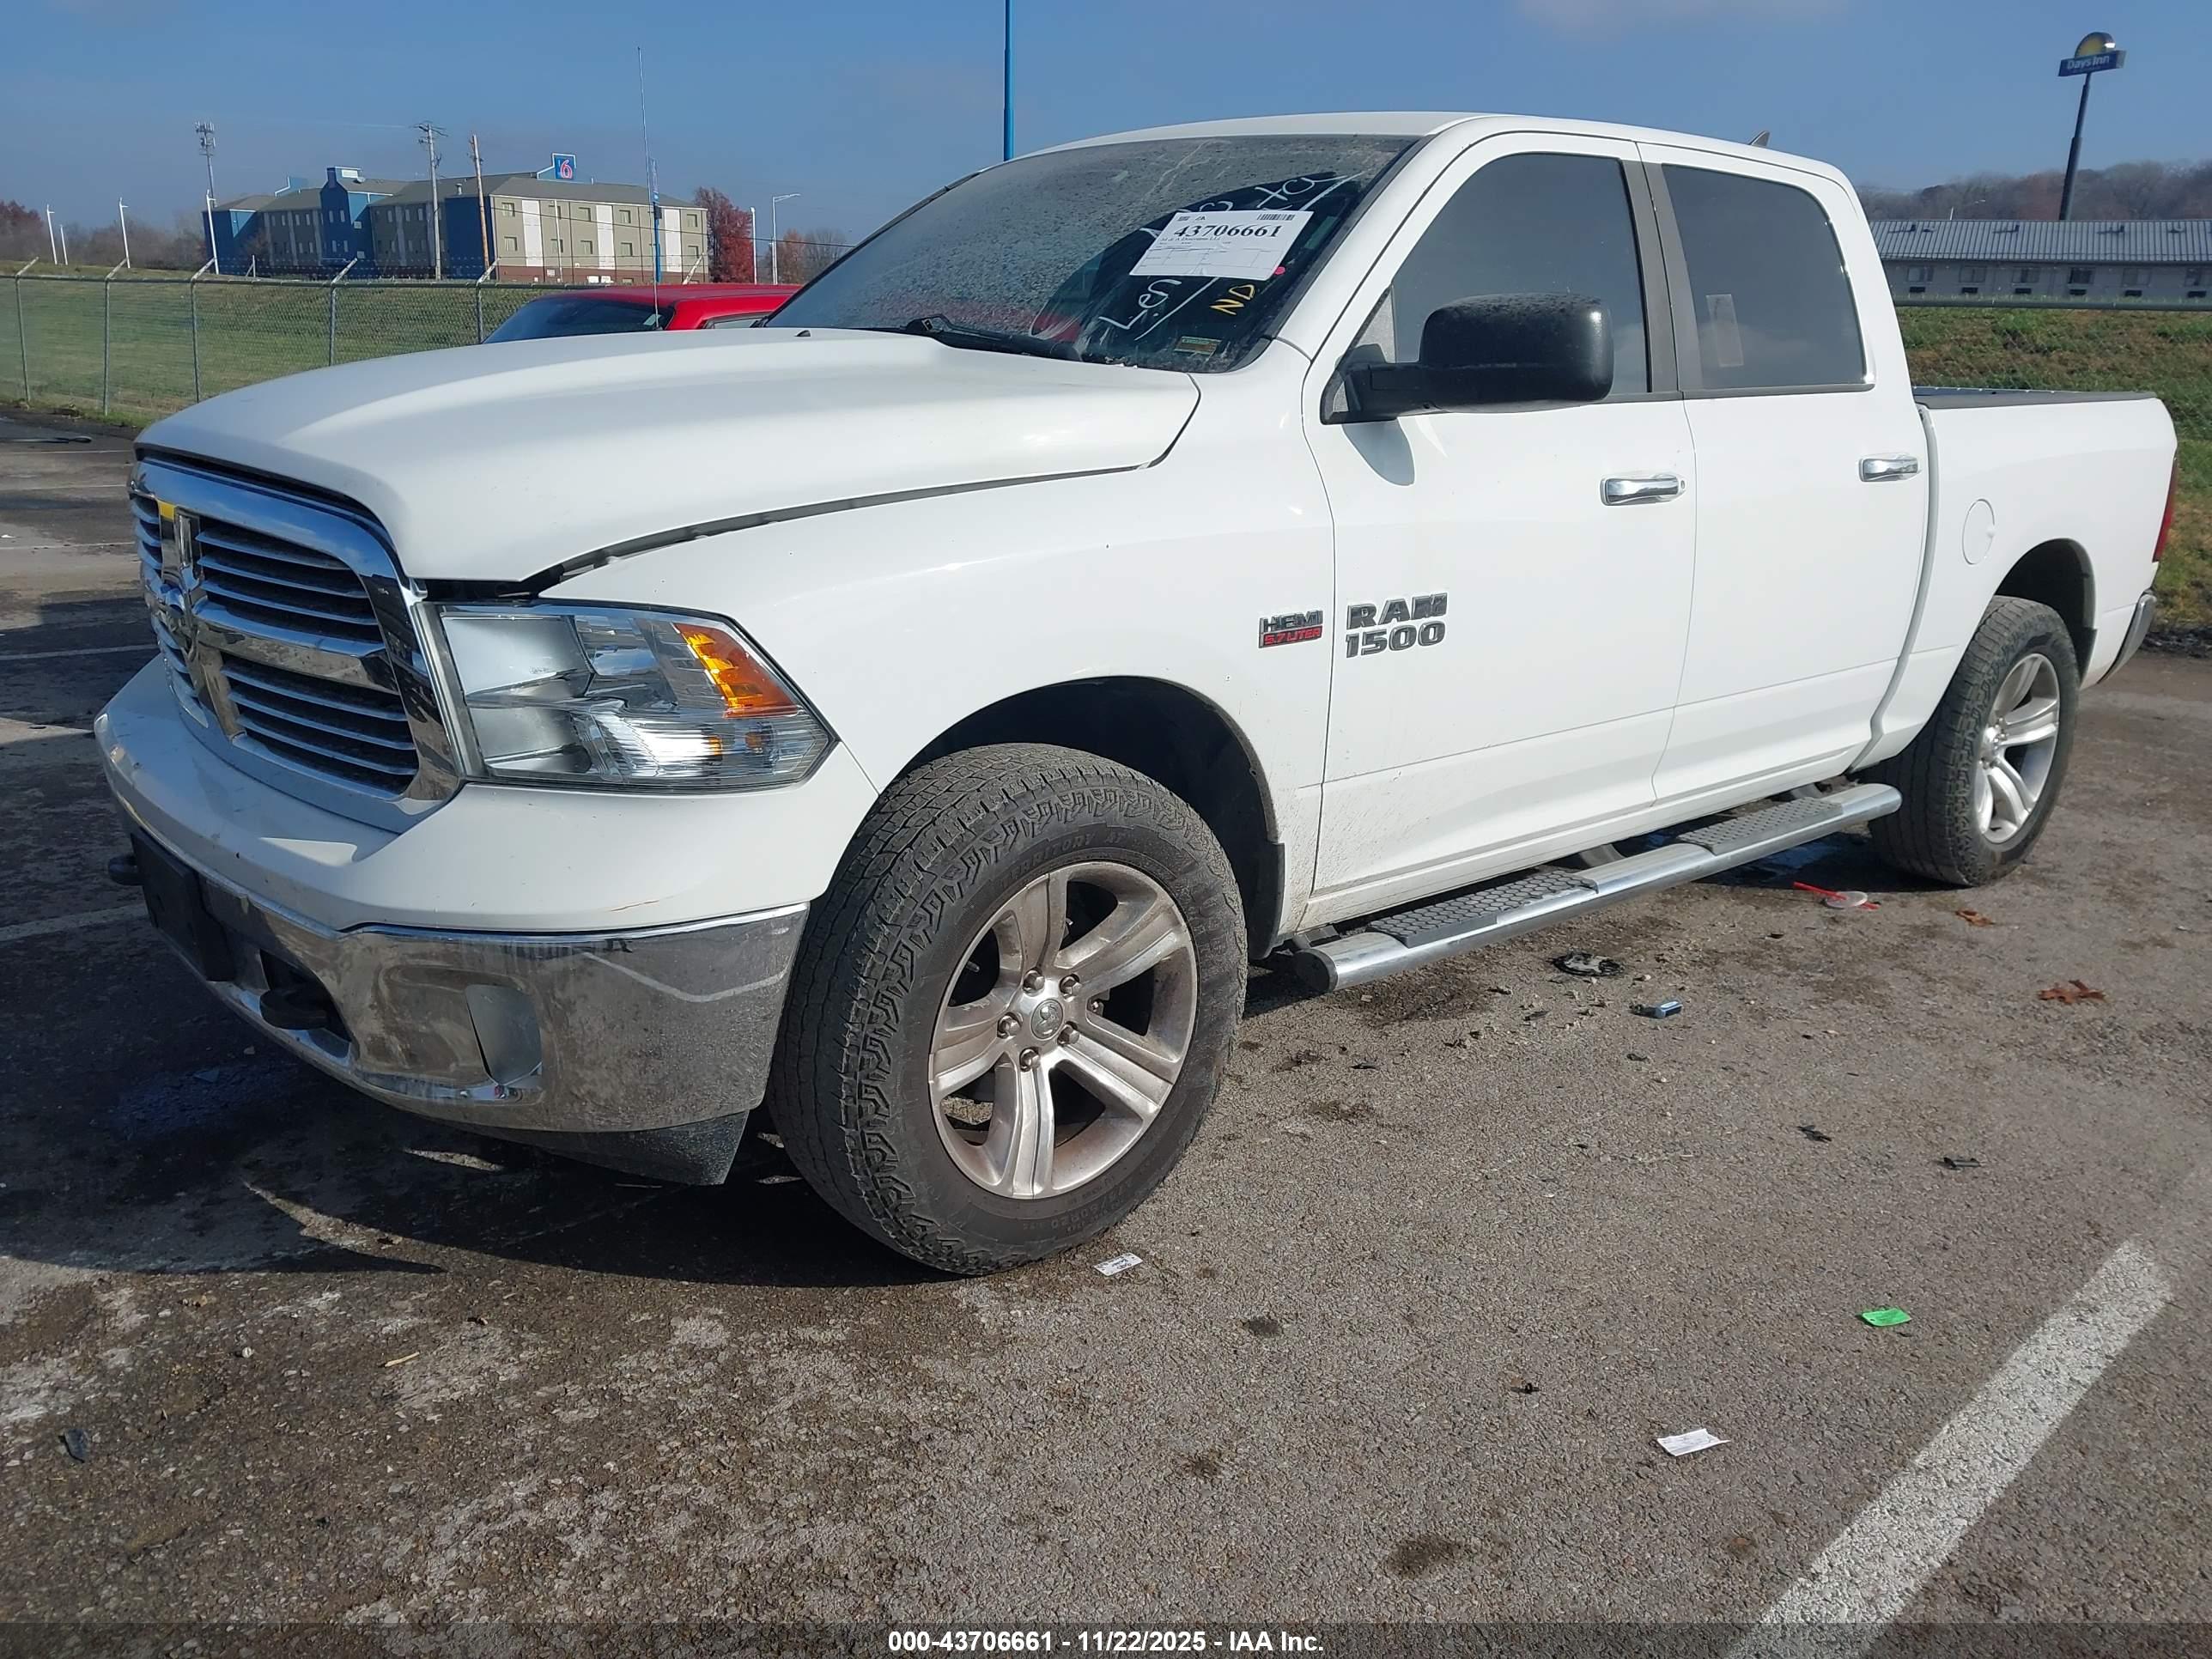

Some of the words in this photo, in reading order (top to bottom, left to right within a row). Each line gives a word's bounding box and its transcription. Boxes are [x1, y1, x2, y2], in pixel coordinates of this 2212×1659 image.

[2068, 59, 2091, 69] Days
[2092, 56, 2110, 65] Inn
[560, 159, 573, 179] 6
[1174, 224, 1282, 238] 43706661
[1259, 610, 1323, 634] HEMI
[1346, 592, 1448, 630] RAM
[1346, 621, 1446, 659] 1500
